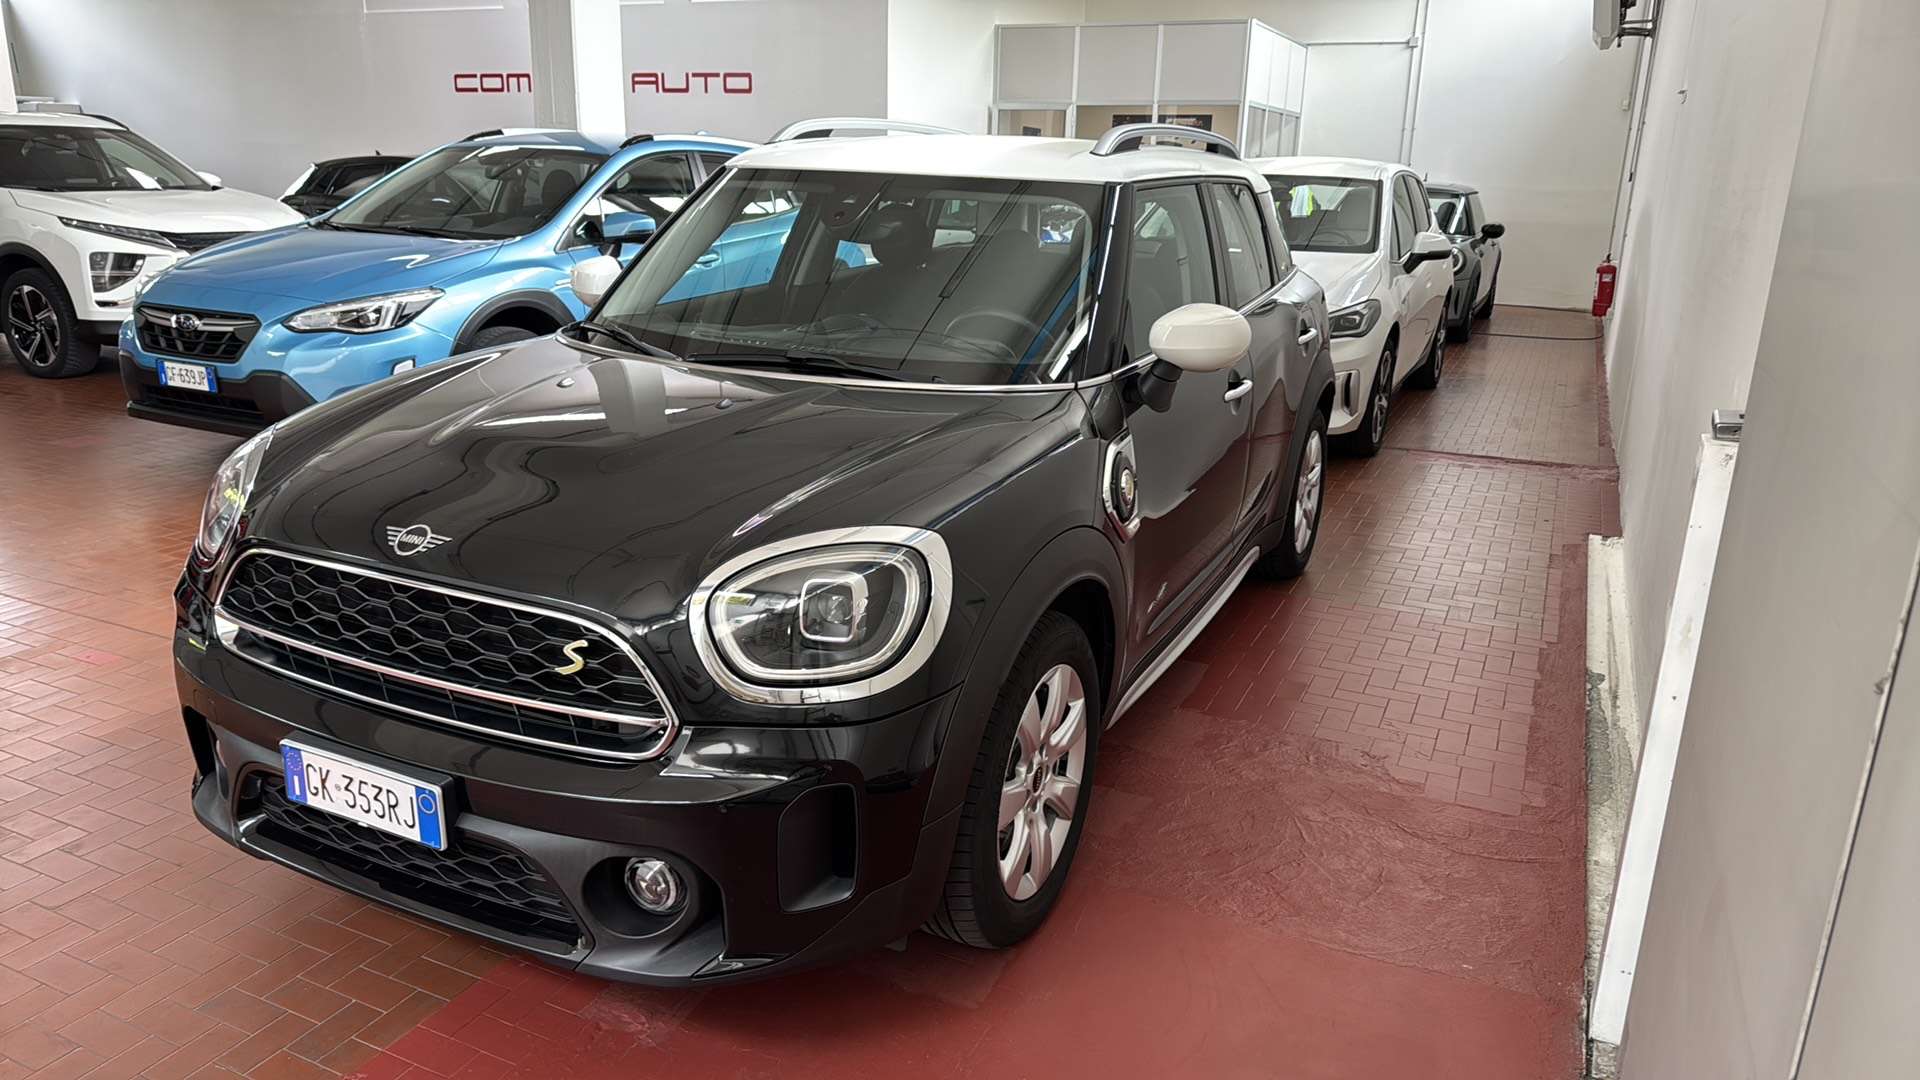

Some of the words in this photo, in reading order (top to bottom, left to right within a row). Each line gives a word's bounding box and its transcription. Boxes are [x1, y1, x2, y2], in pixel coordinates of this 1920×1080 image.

[631, 72, 752, 93] AUTO
[400, 533, 426, 545] MINI
[555, 639, 588, 675] S
